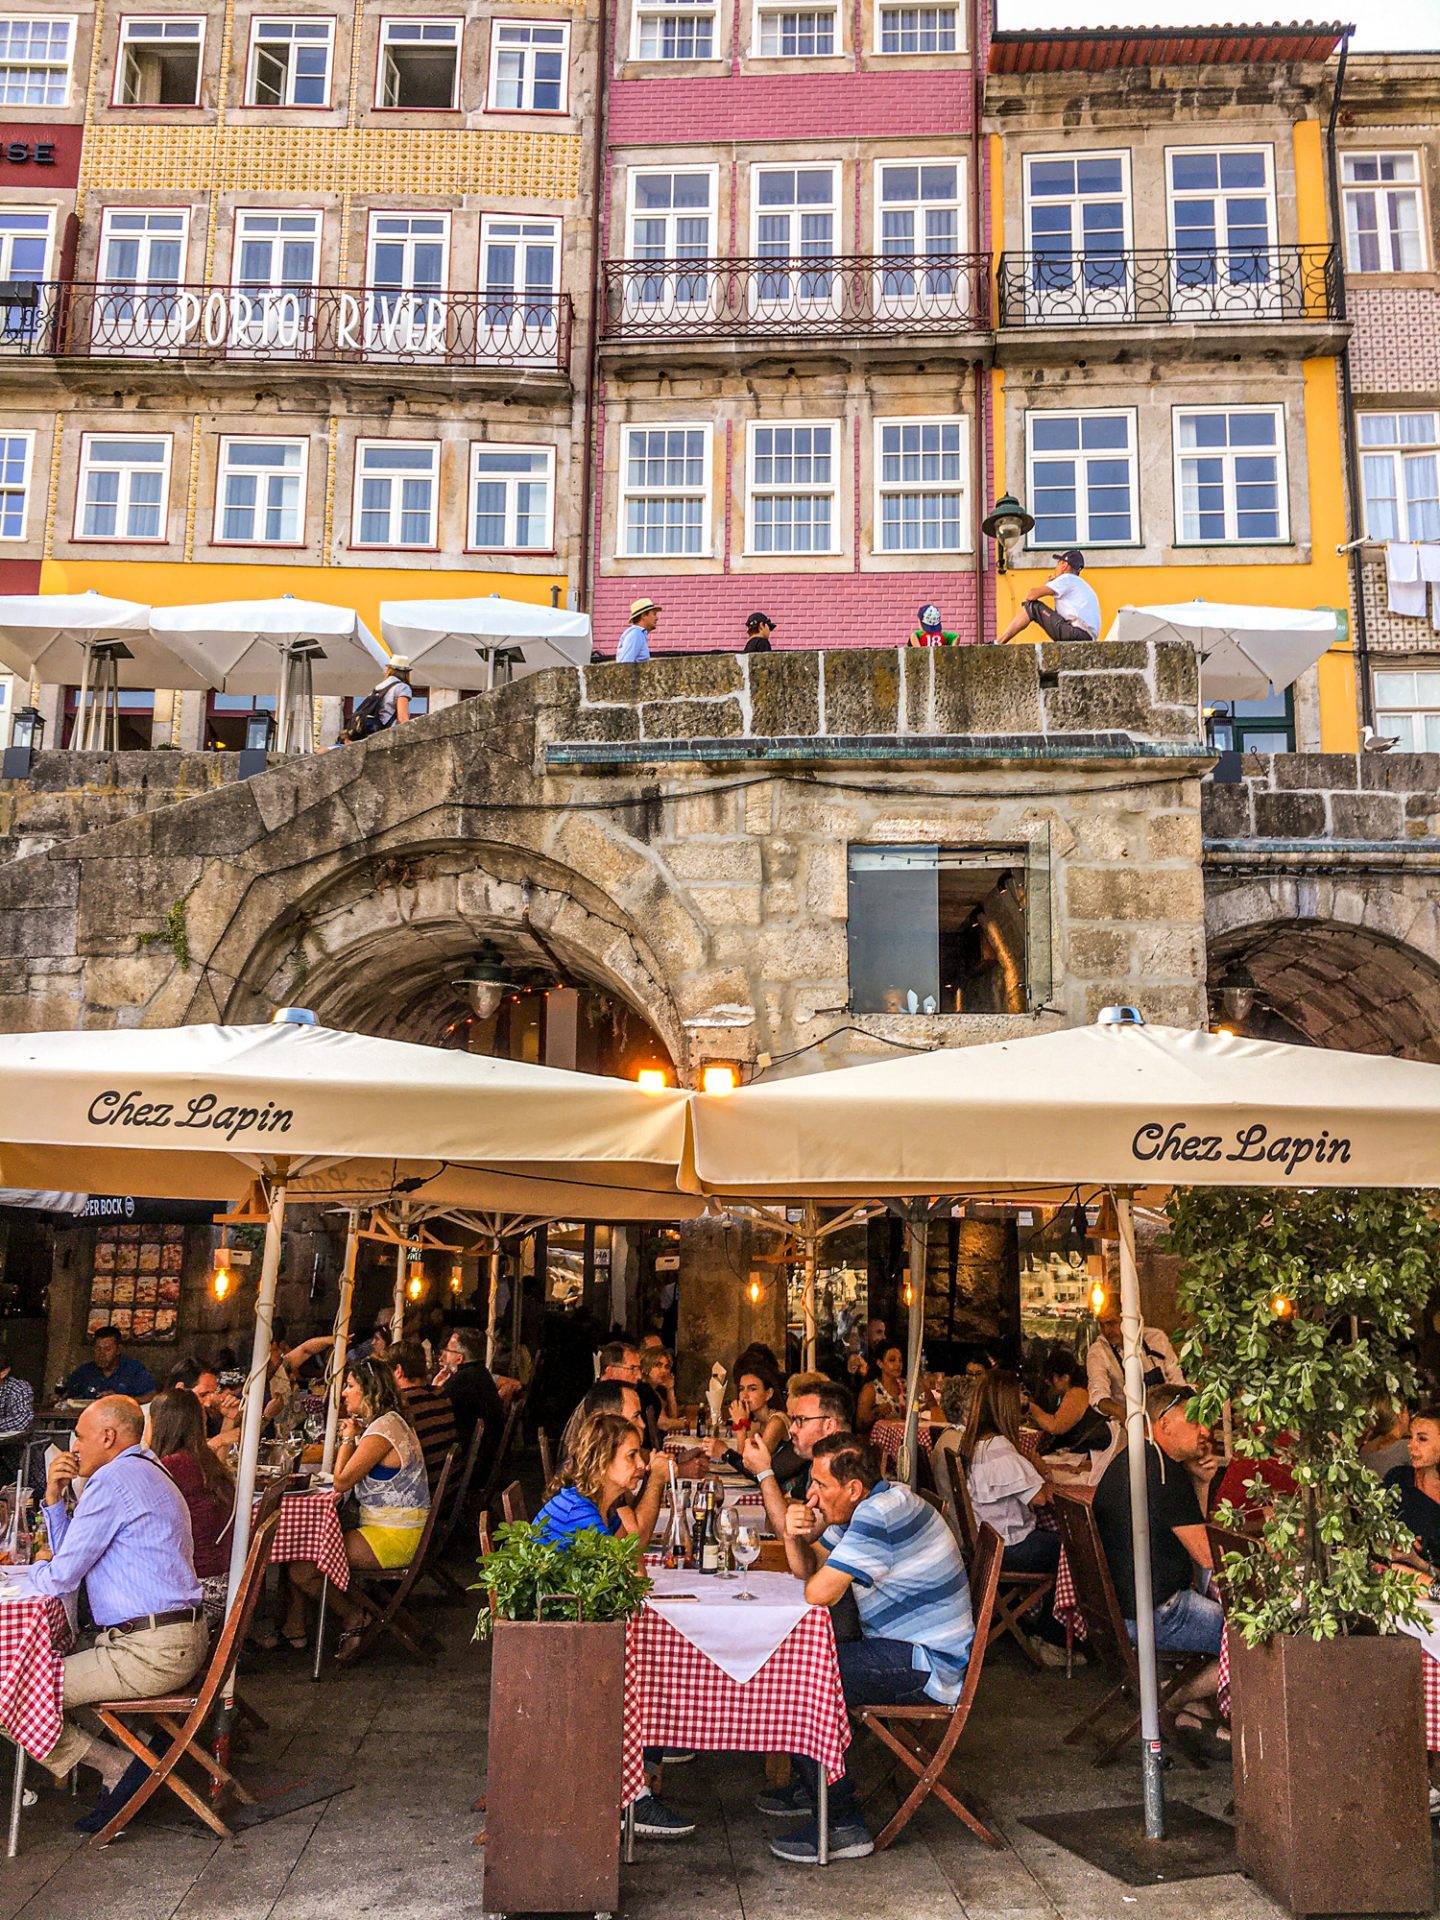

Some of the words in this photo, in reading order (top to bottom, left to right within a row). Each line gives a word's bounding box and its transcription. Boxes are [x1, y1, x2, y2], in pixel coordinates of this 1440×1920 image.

[0, 141, 56, 164] SE
[176, 291, 300, 348] PORTO
[336, 292, 448, 352] RIVER
[925, 634, 942, 647] 18
[88, 1090, 174, 1127] Chez
[174, 1093, 294, 1142] Lapin
[1131, 1122, 1223, 1161] Chez
[1225, 1123, 1352, 1176] Lapin
[73, 1199, 100, 1217] PER
[101, 1198, 123, 1215] BOCK
